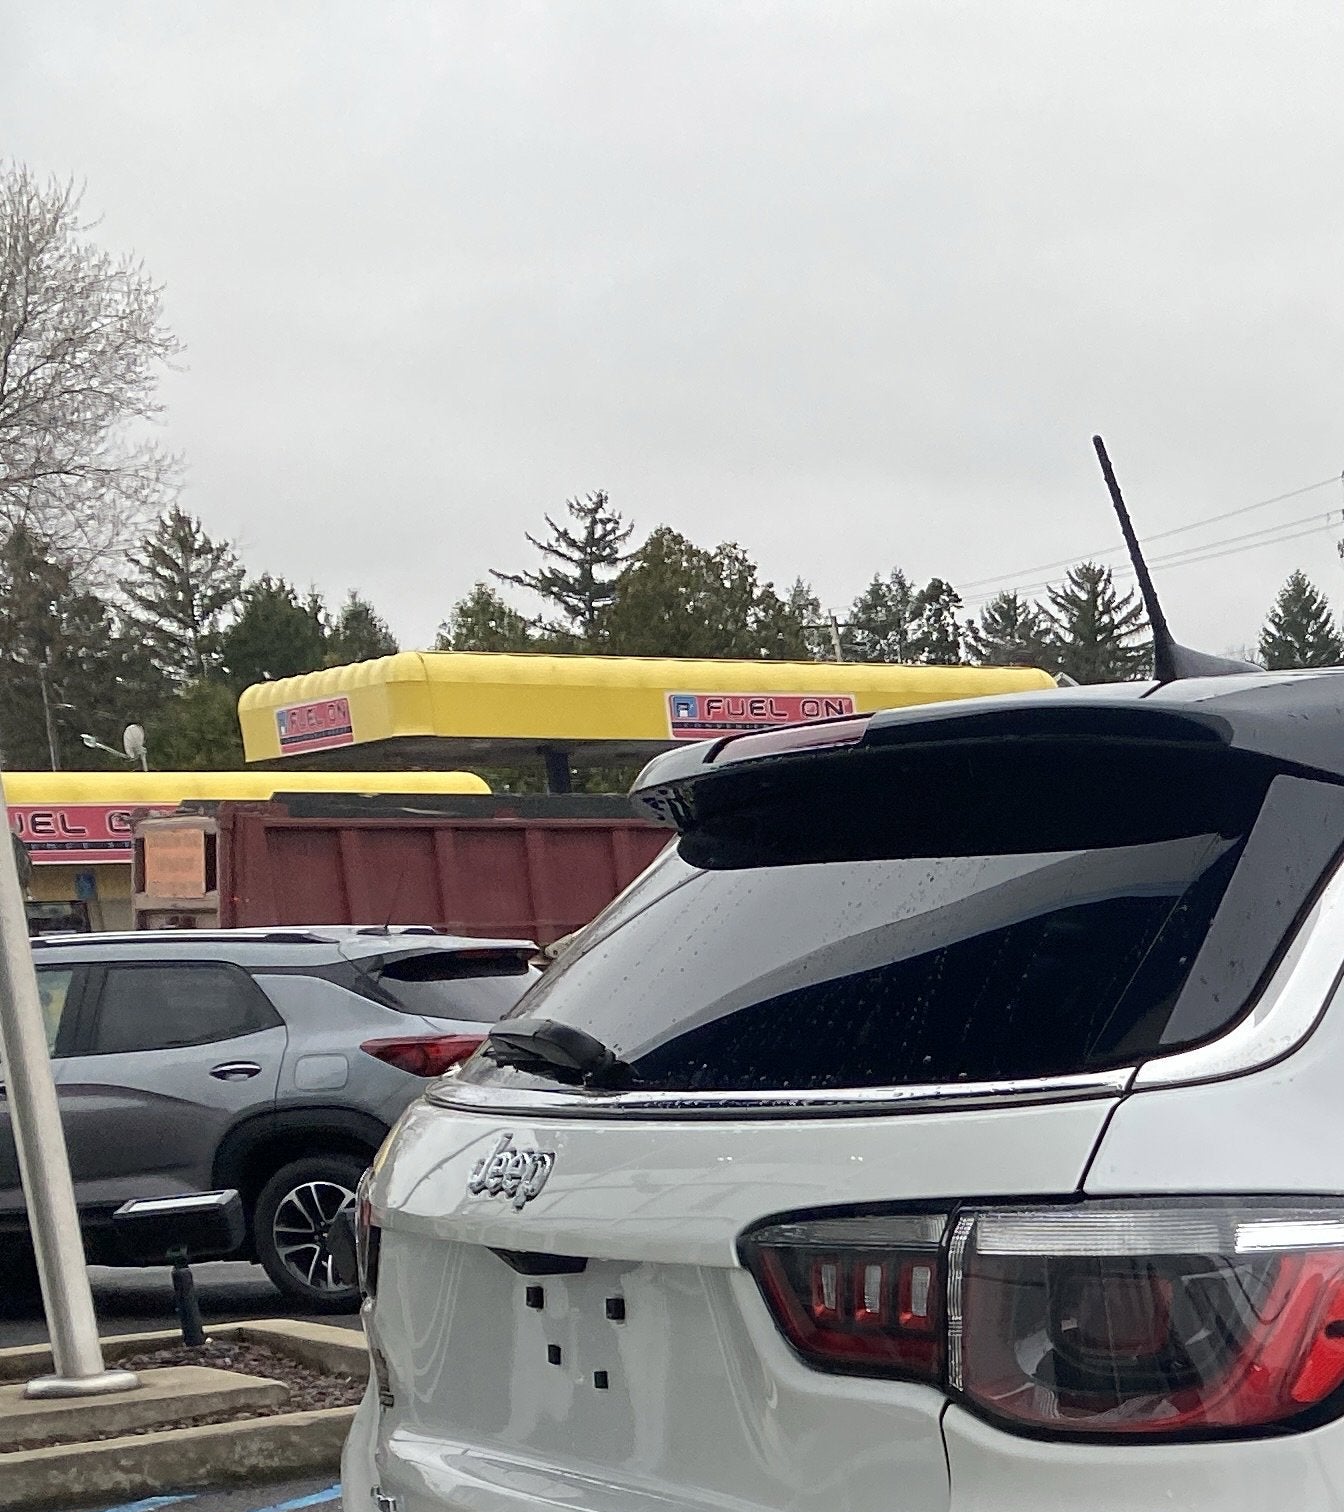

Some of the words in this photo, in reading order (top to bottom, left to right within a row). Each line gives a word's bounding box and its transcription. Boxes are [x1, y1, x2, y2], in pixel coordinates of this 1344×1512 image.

[706, 697, 788, 720] FUEL
[801, 698, 846, 719] ON
[467, 1132, 556, 1213] Jeep
